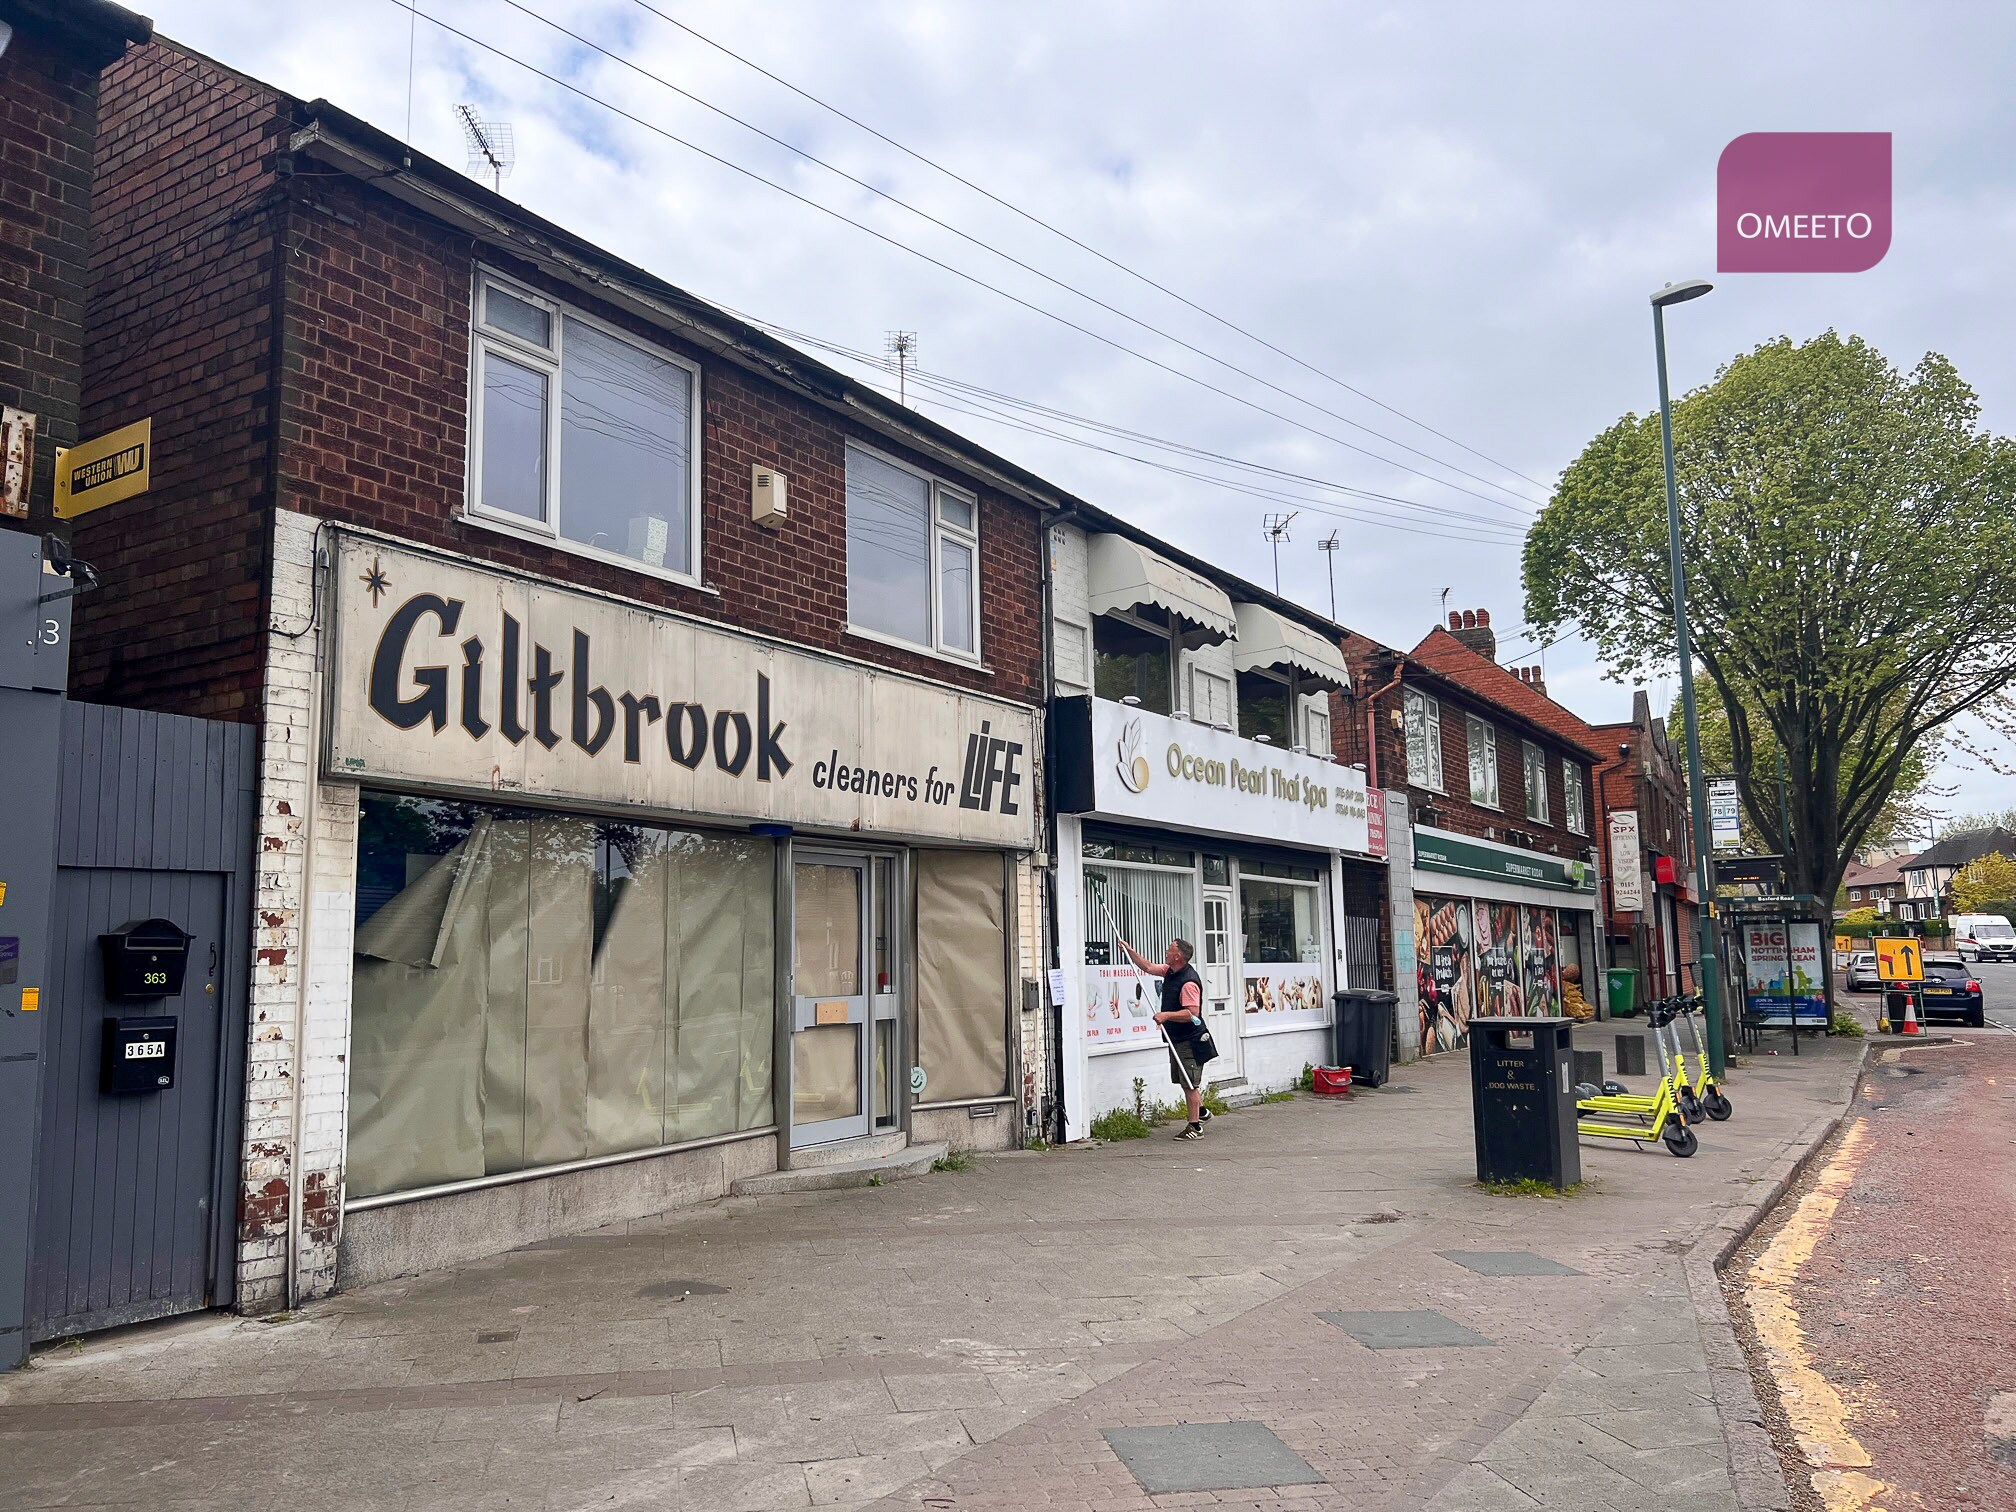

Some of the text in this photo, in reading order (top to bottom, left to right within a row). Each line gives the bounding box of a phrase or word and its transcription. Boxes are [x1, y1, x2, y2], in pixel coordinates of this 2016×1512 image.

[74, 458, 113, 480] WESTERN
[85, 469, 112, 487] UNION
[38, 619, 60, 645] 3
[369, 592, 794, 782] Giltbrook
[813, 749, 918, 801] cleaners
[924, 766, 955, 806] for
[1167, 743, 1226, 787] Ocean
[1231, 758, 1268, 796] Pearl
[1271, 768, 1300, 802] Thai
[1302, 775, 1328, 812] Spa
[1505, 862, 1532, 876] SUPERMARKET
[1749, 931, 1785, 946] BIG
[1751, 946, 1815, 954] NOTTINHAM
[144, 972, 167, 984] 363
[127, 1043, 164, 1057] 365A
[1496, 1059, 1525, 1068] LITTER
[1507, 1070, 1516, 1079] &
[1488, 1082, 1535, 1091] DOG WASTE
